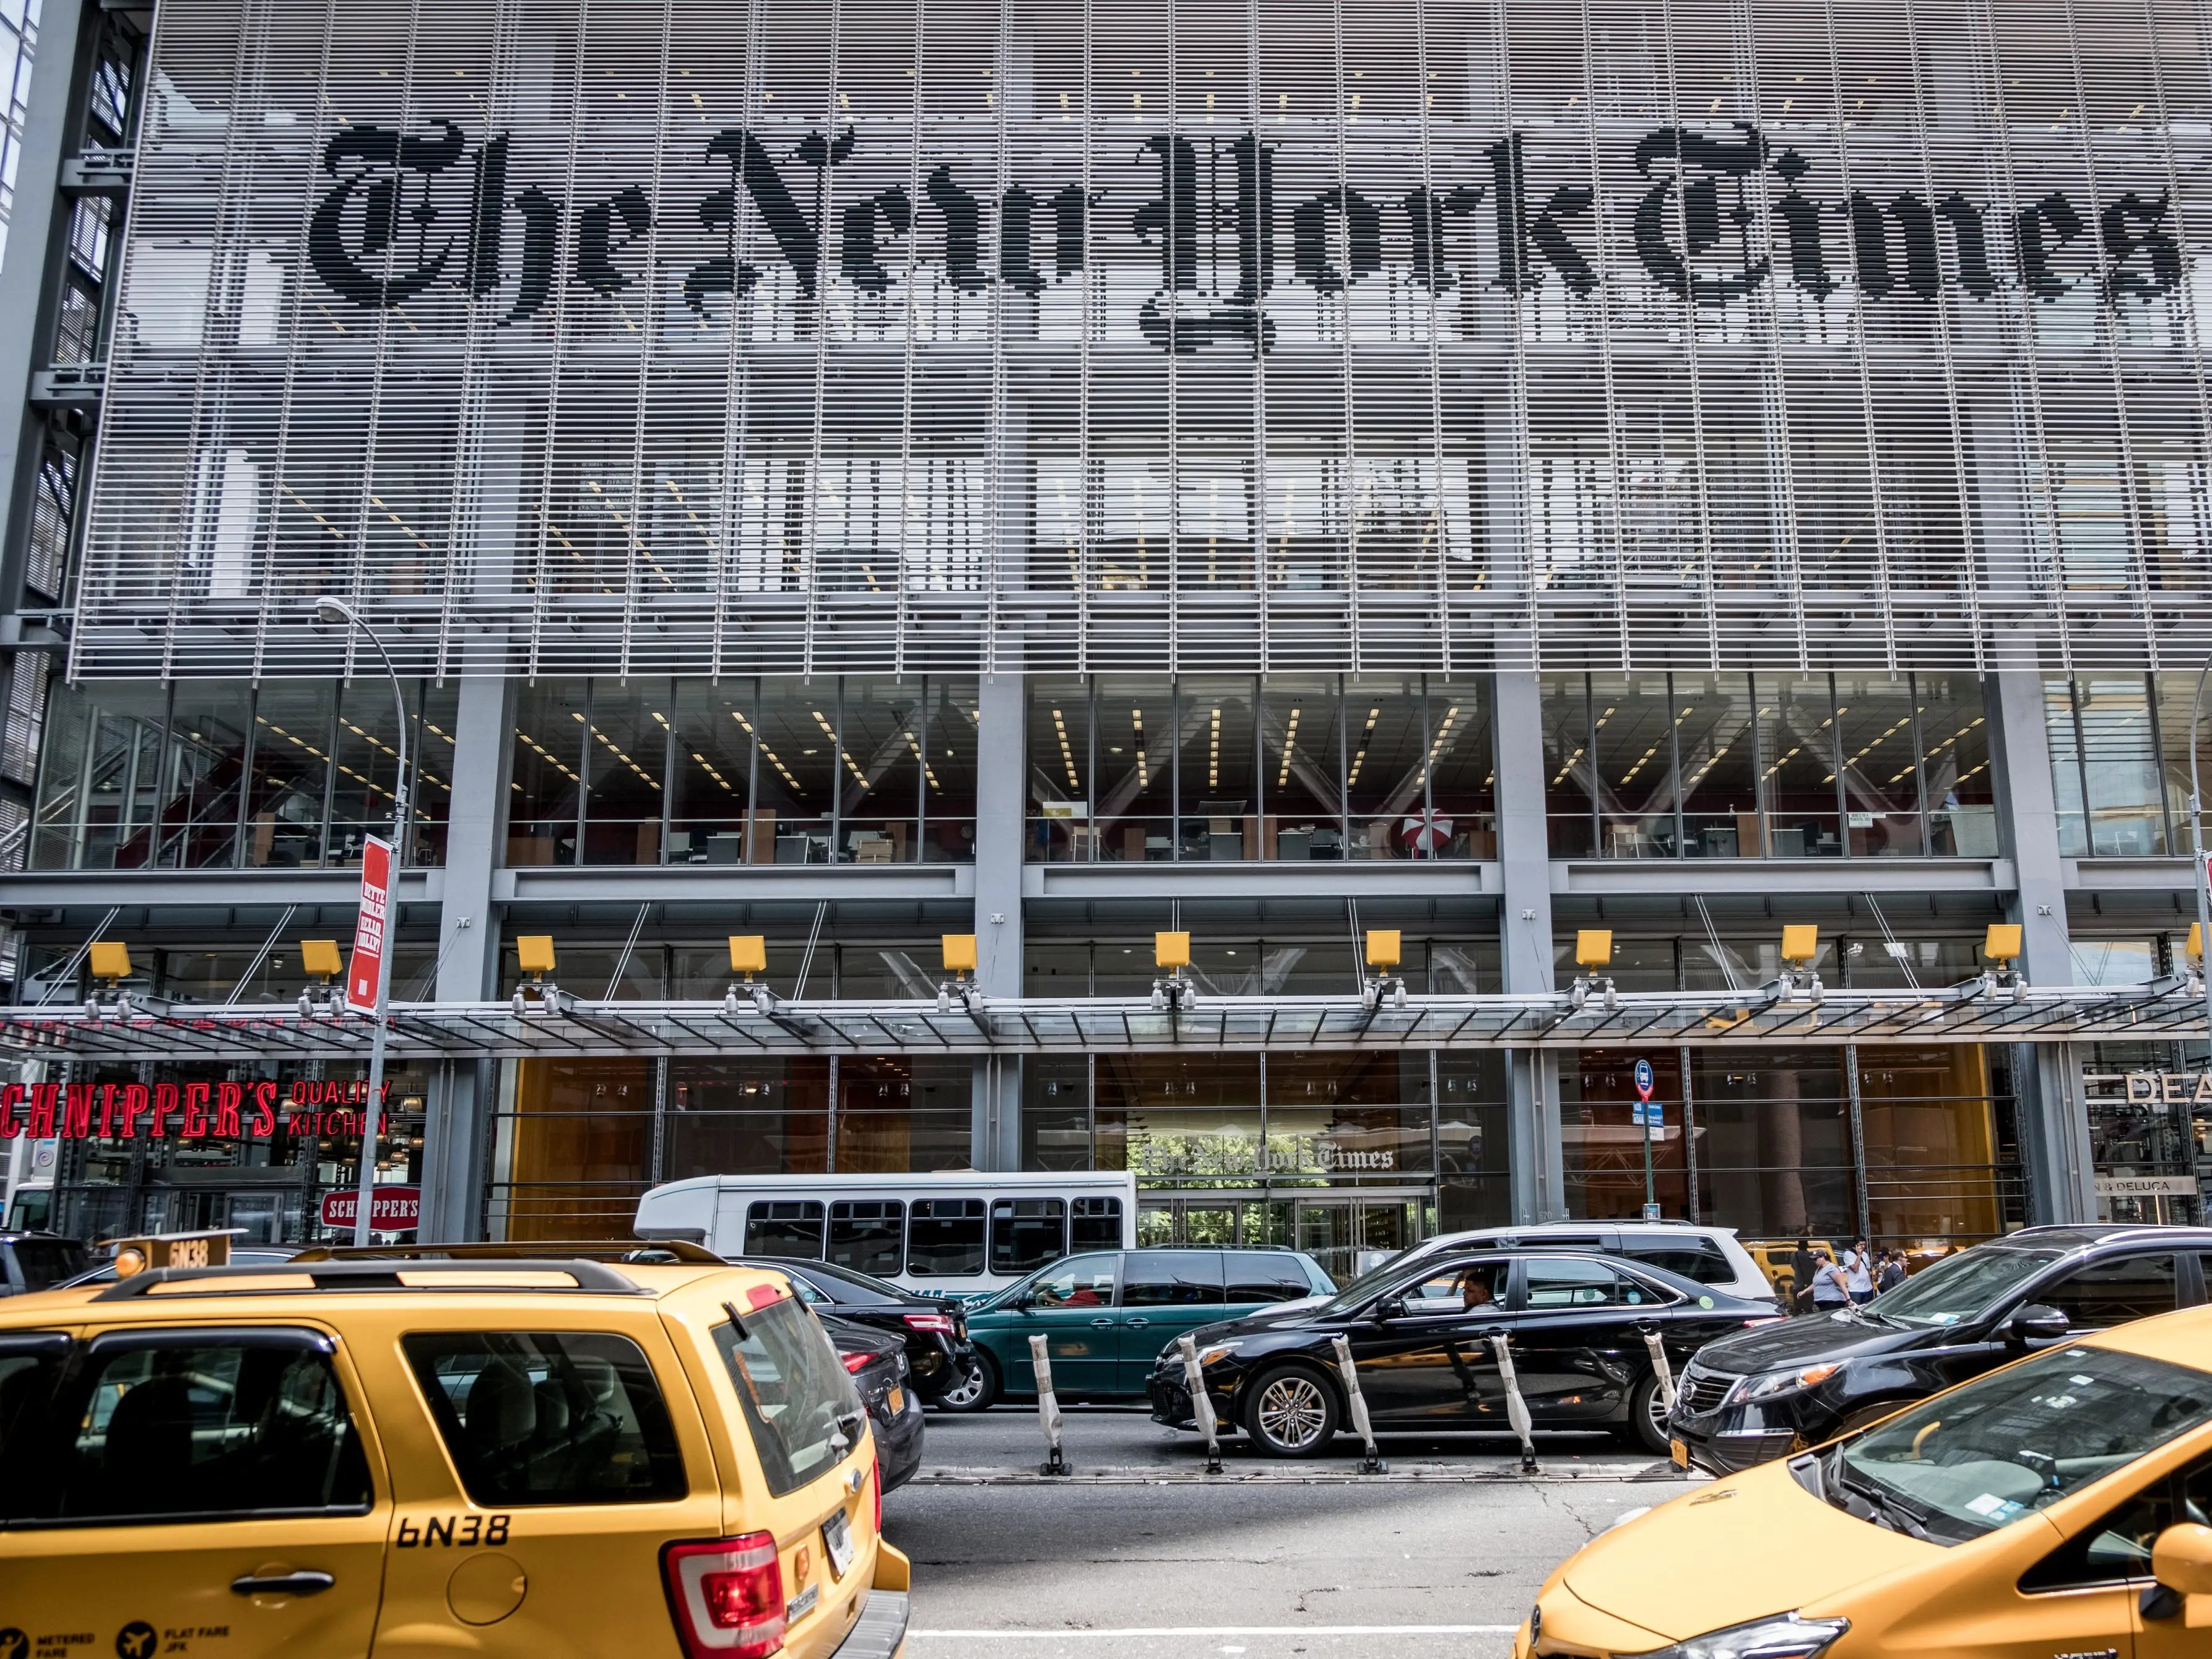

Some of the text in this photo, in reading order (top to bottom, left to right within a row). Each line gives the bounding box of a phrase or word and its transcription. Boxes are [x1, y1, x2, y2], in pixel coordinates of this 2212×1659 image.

[310, 118, 2183, 359] The New York Times
[363, 881, 385, 904] BETTE
[1142, 1141, 1394, 1180] The New York Times
[2117, 1182, 2171, 1191] DELUCA
[329, 1200, 419, 1218] SCHPPER'S
[169, 1239, 209, 1269] 6N38
[37, 1632, 95, 1646] METERED
[164, 1626, 230, 1640] FLAT FARE
[36, 1647, 67, 1658] FARE
[164, 1642, 188, 1653] JFK
